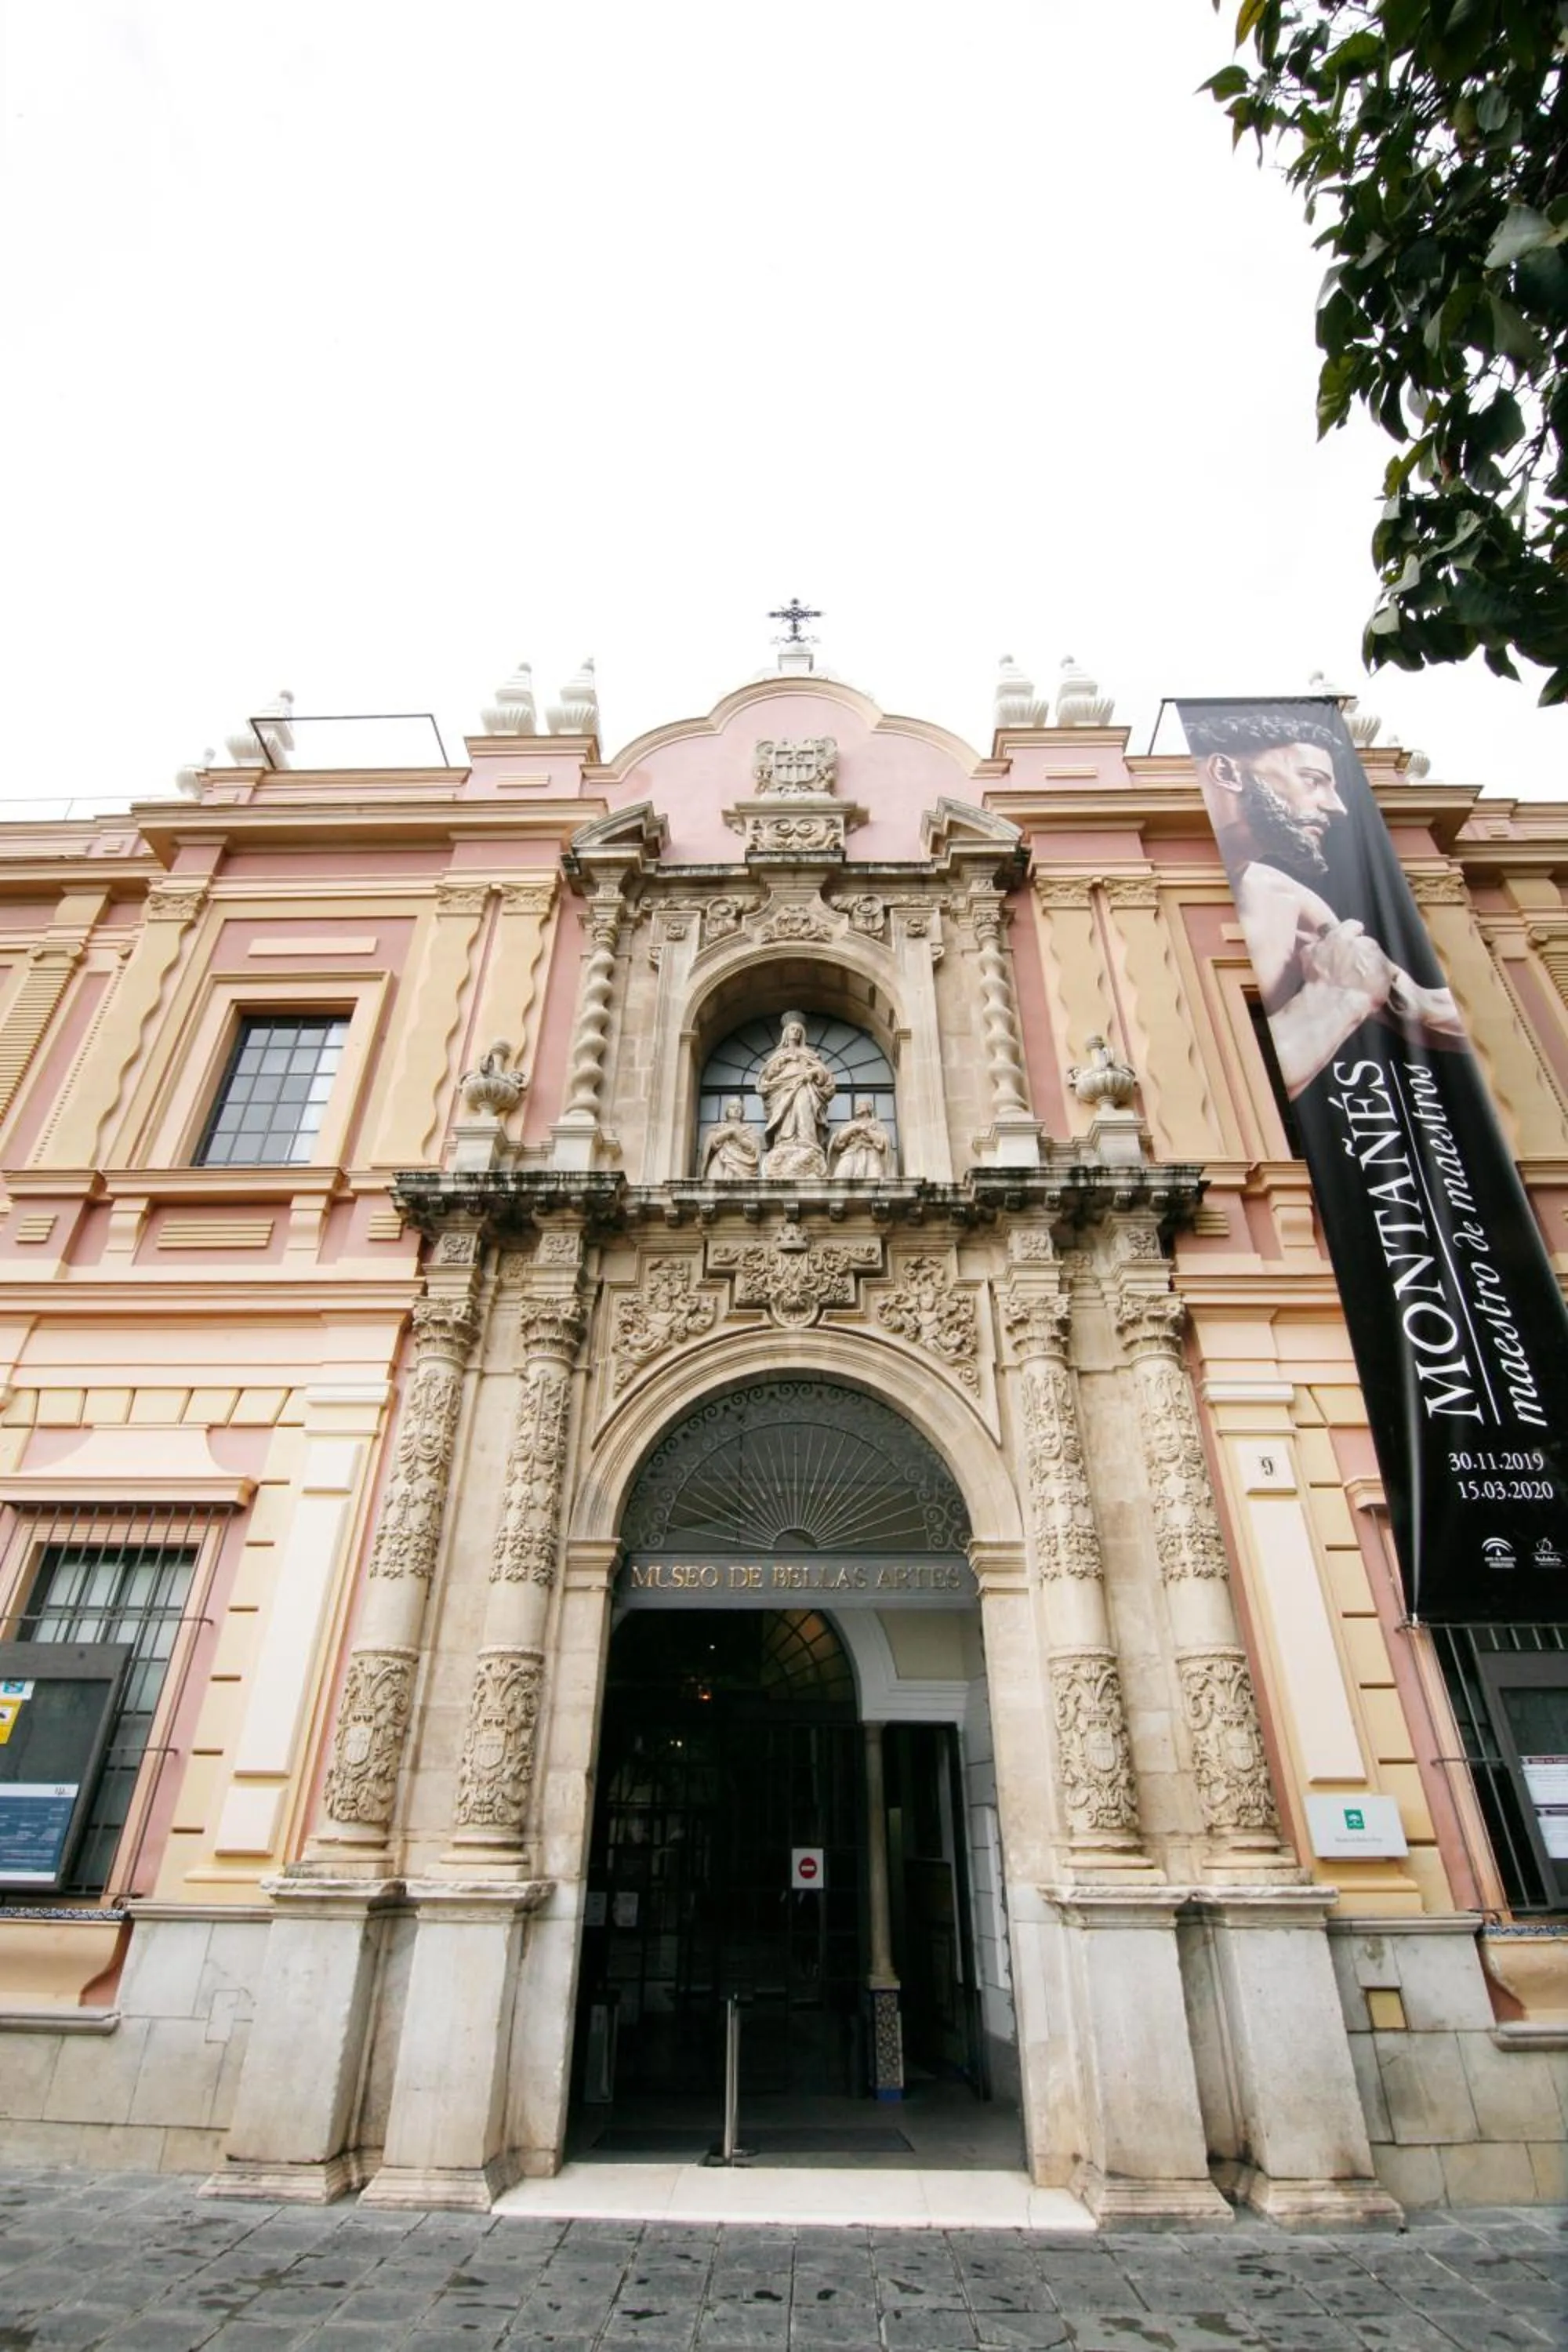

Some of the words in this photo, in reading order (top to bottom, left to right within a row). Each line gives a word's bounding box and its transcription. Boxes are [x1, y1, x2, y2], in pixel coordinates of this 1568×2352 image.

[1403, 1063, 1477, 1214] maestros
[1327, 1060, 1484, 1425] MONTAÑÉS
[1451, 1220, 1490, 1253] de
[1470, 1261, 1548, 1426] maestro
[1448, 1452, 1544, 1472] 30.11.2019
[1457, 1480, 1554, 1500] 15.03.2020
[630, 1565, 719, 1588] MUSEO
[727, 1566, 764, 1588] DE
[771, 1566, 867, 1589] BELLAS
[875, 1566, 962, 1590] ARTES
